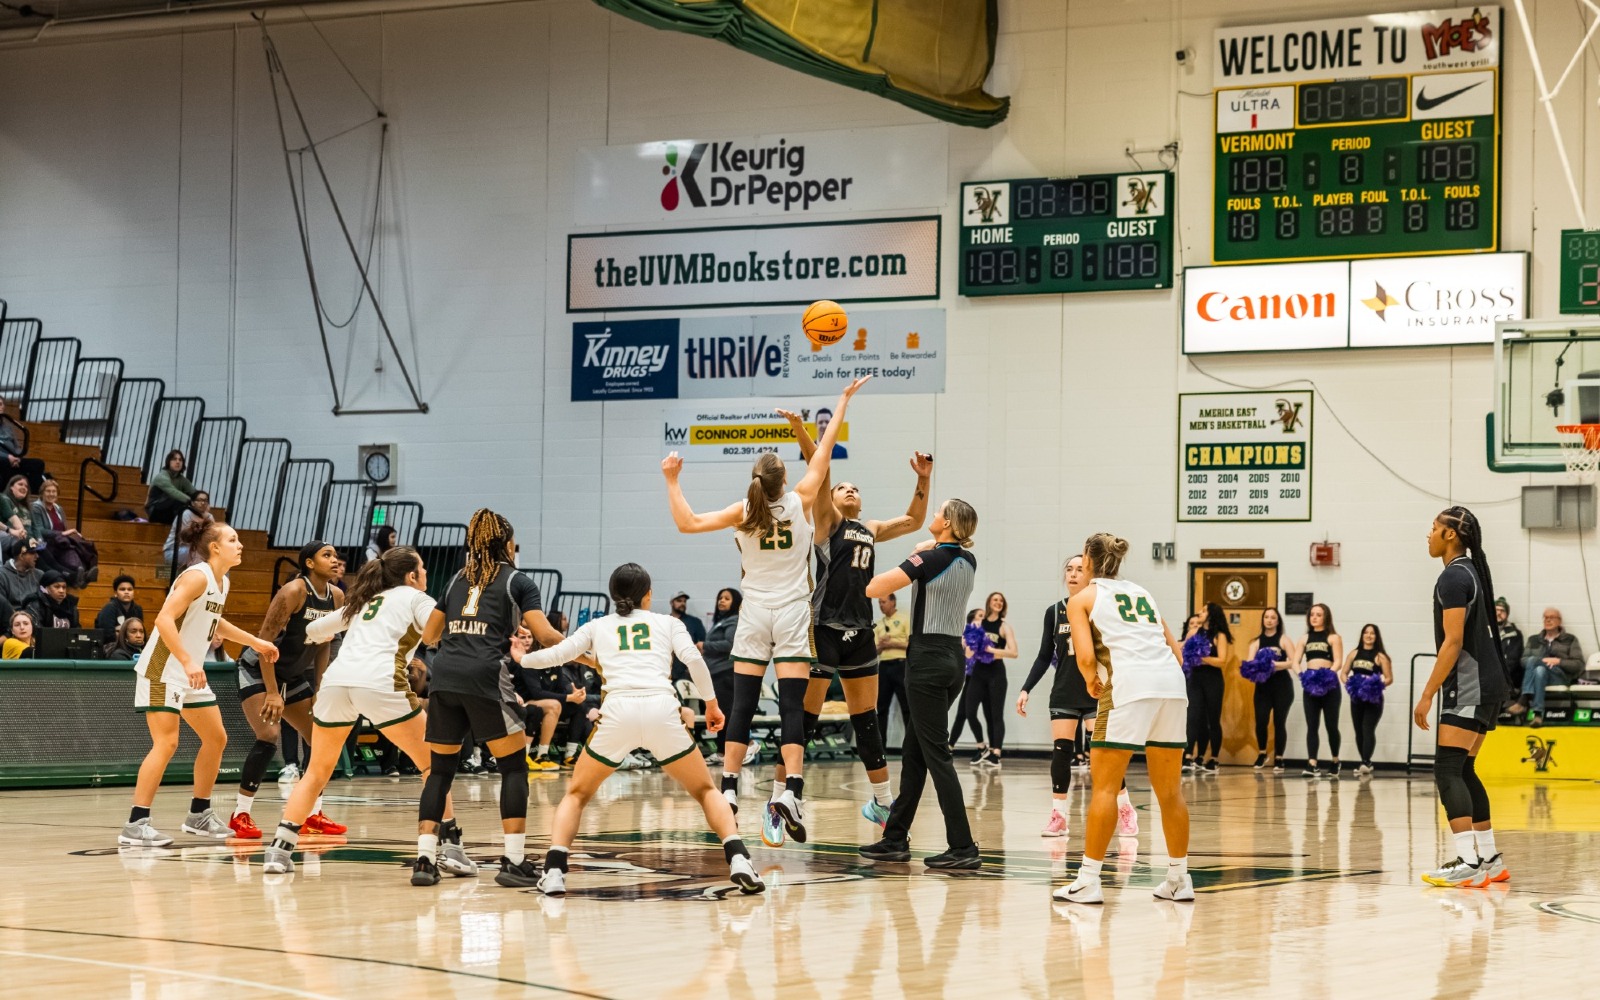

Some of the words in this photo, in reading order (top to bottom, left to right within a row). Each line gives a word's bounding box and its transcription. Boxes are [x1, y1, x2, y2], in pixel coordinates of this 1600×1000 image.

[1220, 28, 1362, 76] WELCOME
[1374, 25, 1407, 64] TO
[1423, 61, 1468, 69] southwest
[1471, 58, 1489, 67] grill
[1231, 98, 1280, 112] ULTRA
[1421, 120, 1475, 140] GUEST
[1221, 132, 1295, 153] VERMONT
[1332, 137, 1371, 150] PERIOD
[711, 138, 805, 176] Keurig
[1227, 197, 1261, 211] FOULS
[1273, 196, 1302, 208] T.O.L.
[1313, 193, 1353, 206] PLAYER
[1361, 190, 1389, 203] FOUL
[1401, 189, 1431, 201] T.O.L.
[1444, 185, 1480, 198] FOULS
[971, 227, 1013, 244] HOME
[1107, 220, 1157, 238] GUEST
[1043, 233, 1080, 246] PERIOD
[594, 250, 907, 287] theUVMBookstore.com
[1197, 291, 1335, 322] Canon
[583, 331, 669, 372] Kinney
[782, 334, 791, 378] REWARDS
[812, 354, 832, 362] Deals
[858, 353, 880, 361] Points
[901, 351, 936, 359] Rewarded
[603, 366, 647, 378] DRUGS
[812, 369, 833, 379] Join
[836, 368, 851, 378] for
[854, 367, 878, 378] FREE
[882, 366, 915, 379] today!
[751, 412, 767, 420] UVM
[1199, 409, 1234, 417] AMERICA
[1237, 408, 1257, 416] EAST
[665, 422, 687, 441] kw
[1190, 421, 1215, 430] MEN'S
[1217, 420, 1266, 429] BASKETBALL
[695, 429, 747, 440] CONNOR
[1188, 445, 1301, 466] CHAMPIONS
[1188, 474, 1208, 483] 2003
[1218, 474, 1238, 483] 2004
[1249, 474, 1269, 483] 2005
[1281, 473, 1300, 482] 2010
[1188, 490, 1207, 499] 2012
[1219, 490, 1237, 499] 2017
[1249, 490, 1268, 499] 2019
[1280, 489, 1301, 498] 2020
[1187, 506, 1207, 515] 2022
[1218, 505, 1238, 515] 2023
[1248, 505, 1269, 515] 2024
[760, 519, 793, 550] 25
[851, 545, 872, 569] 10
[362, 595, 385, 621] 3
[462, 585, 481, 616] 1
[1114, 593, 1158, 624] 24
[617, 623, 651, 651] 12
